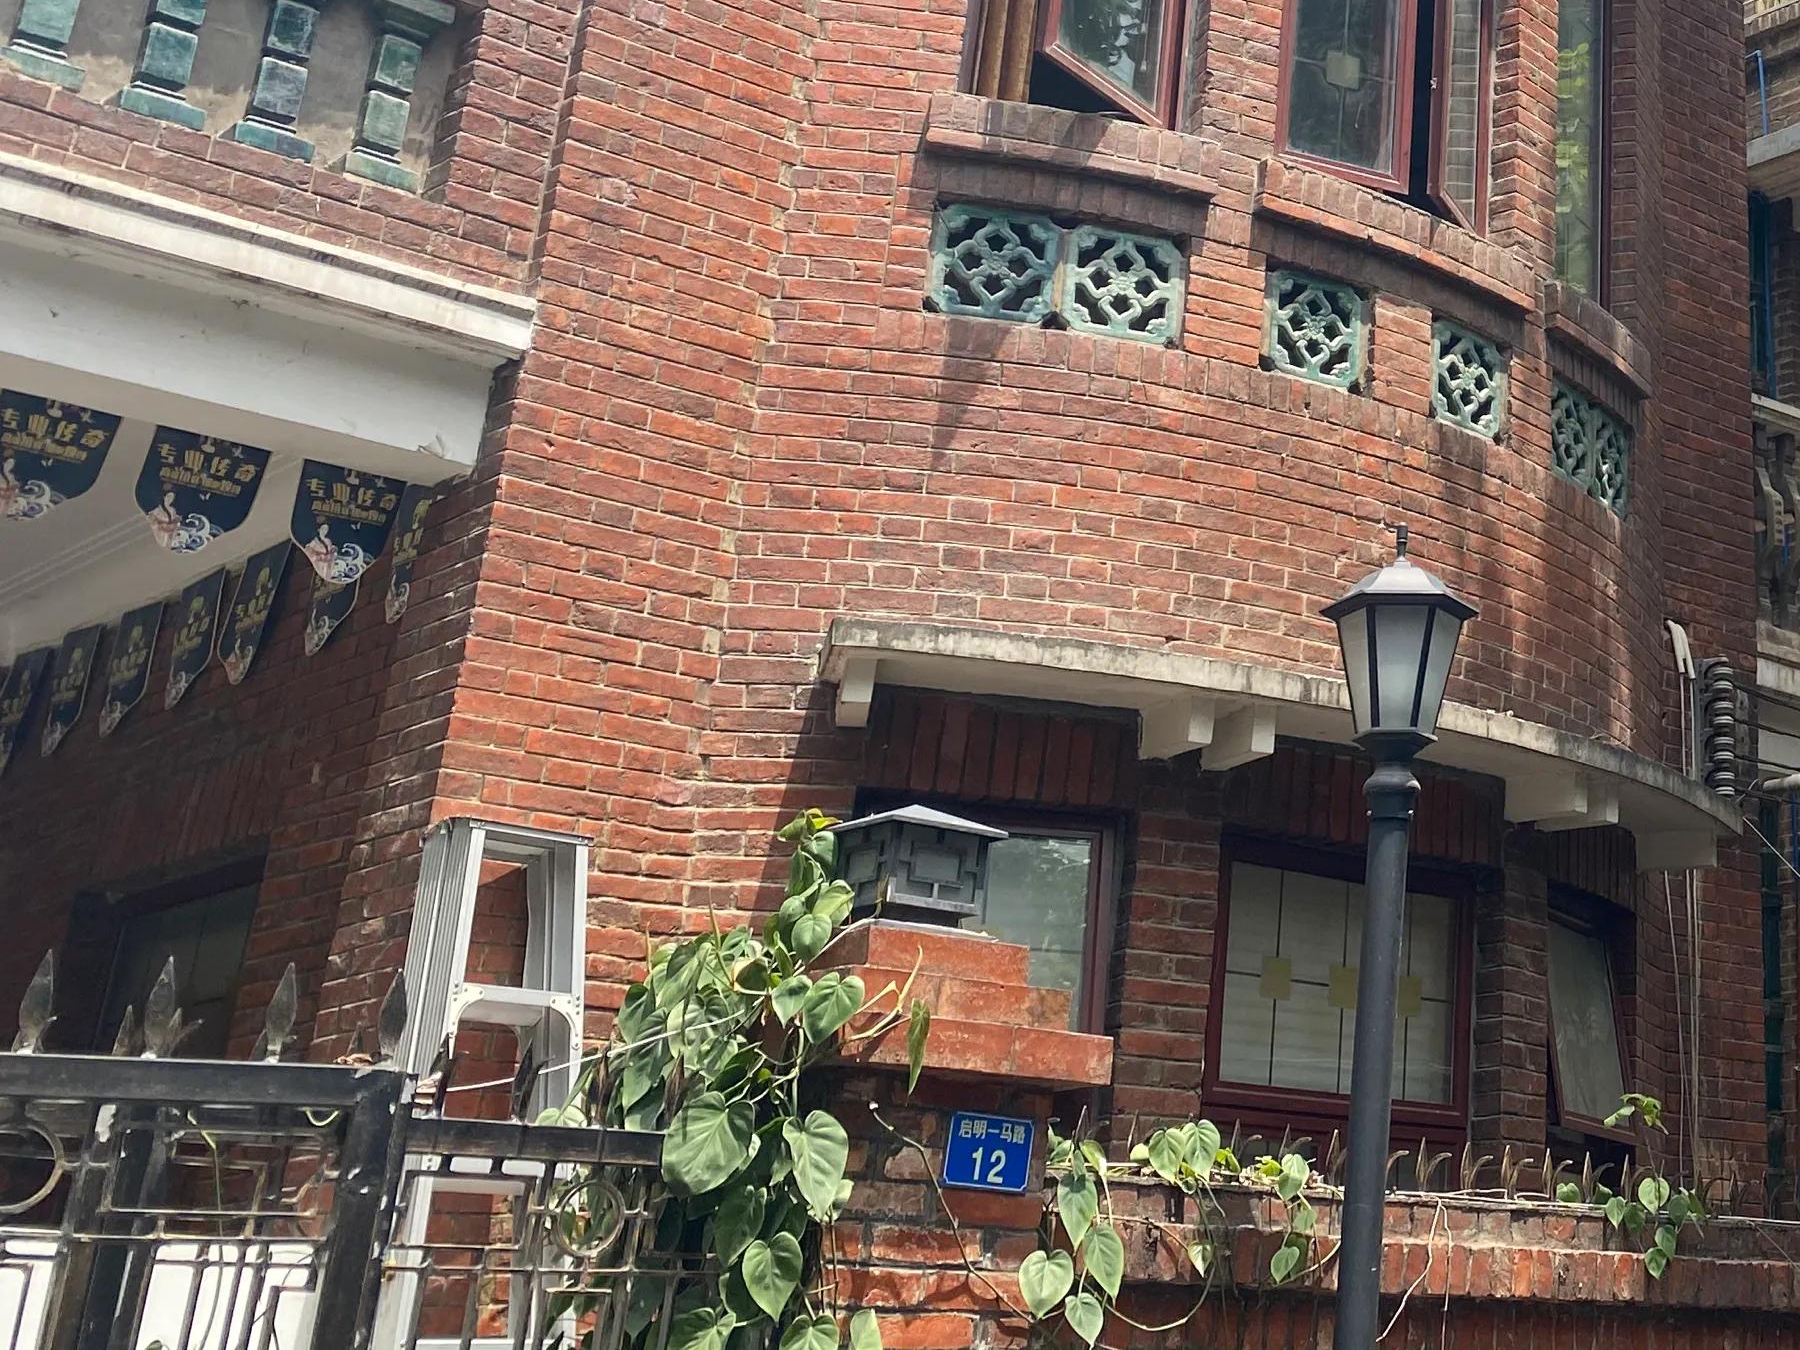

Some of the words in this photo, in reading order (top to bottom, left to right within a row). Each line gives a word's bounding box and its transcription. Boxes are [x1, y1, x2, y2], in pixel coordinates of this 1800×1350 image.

[958, 1119, 1026, 1145] 启明一马路
[971, 1146, 1006, 1184] 12
